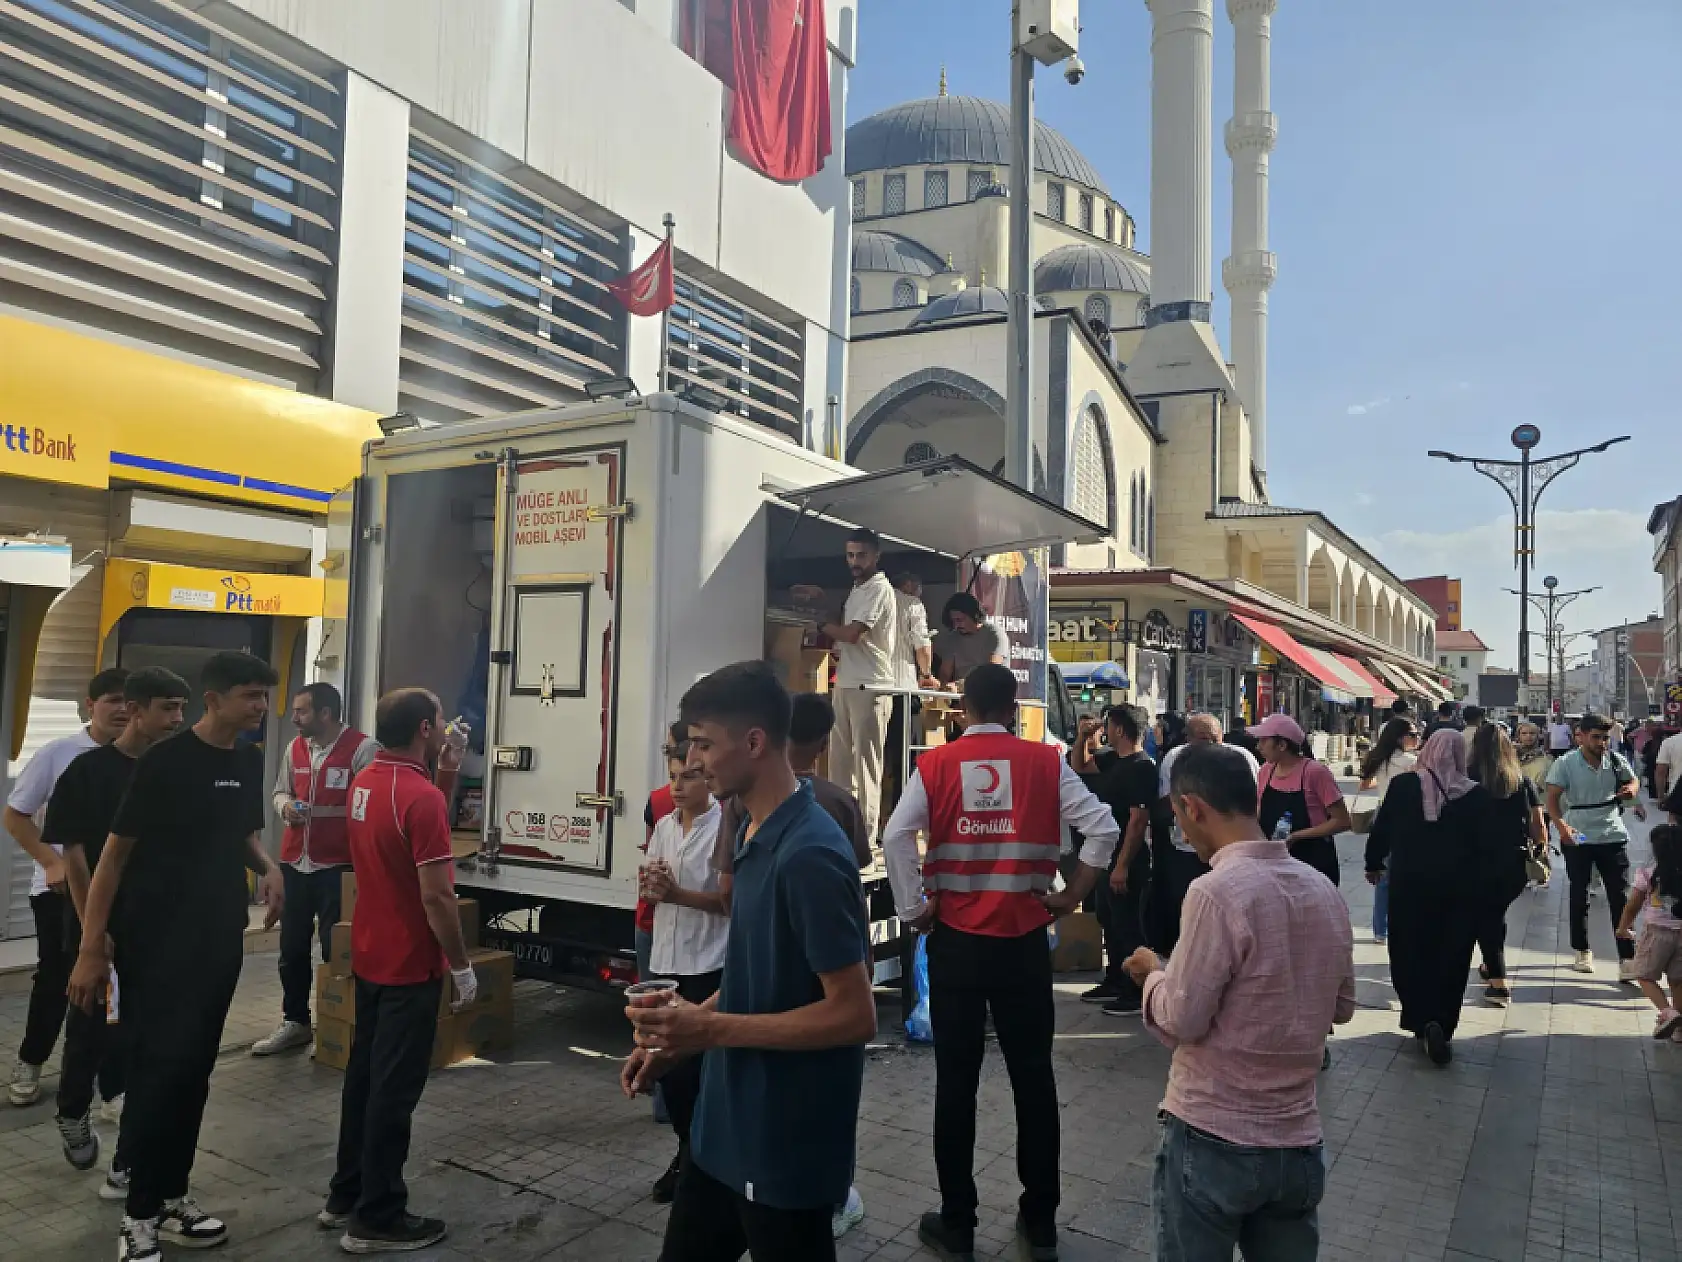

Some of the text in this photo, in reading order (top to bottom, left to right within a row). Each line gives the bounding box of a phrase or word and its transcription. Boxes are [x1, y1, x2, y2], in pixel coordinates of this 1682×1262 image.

[516, 488, 588, 510] MÜGE ANLI
[516, 513, 530, 528] VE
[515, 524, 586, 546] MOBİL AŞEVİ
